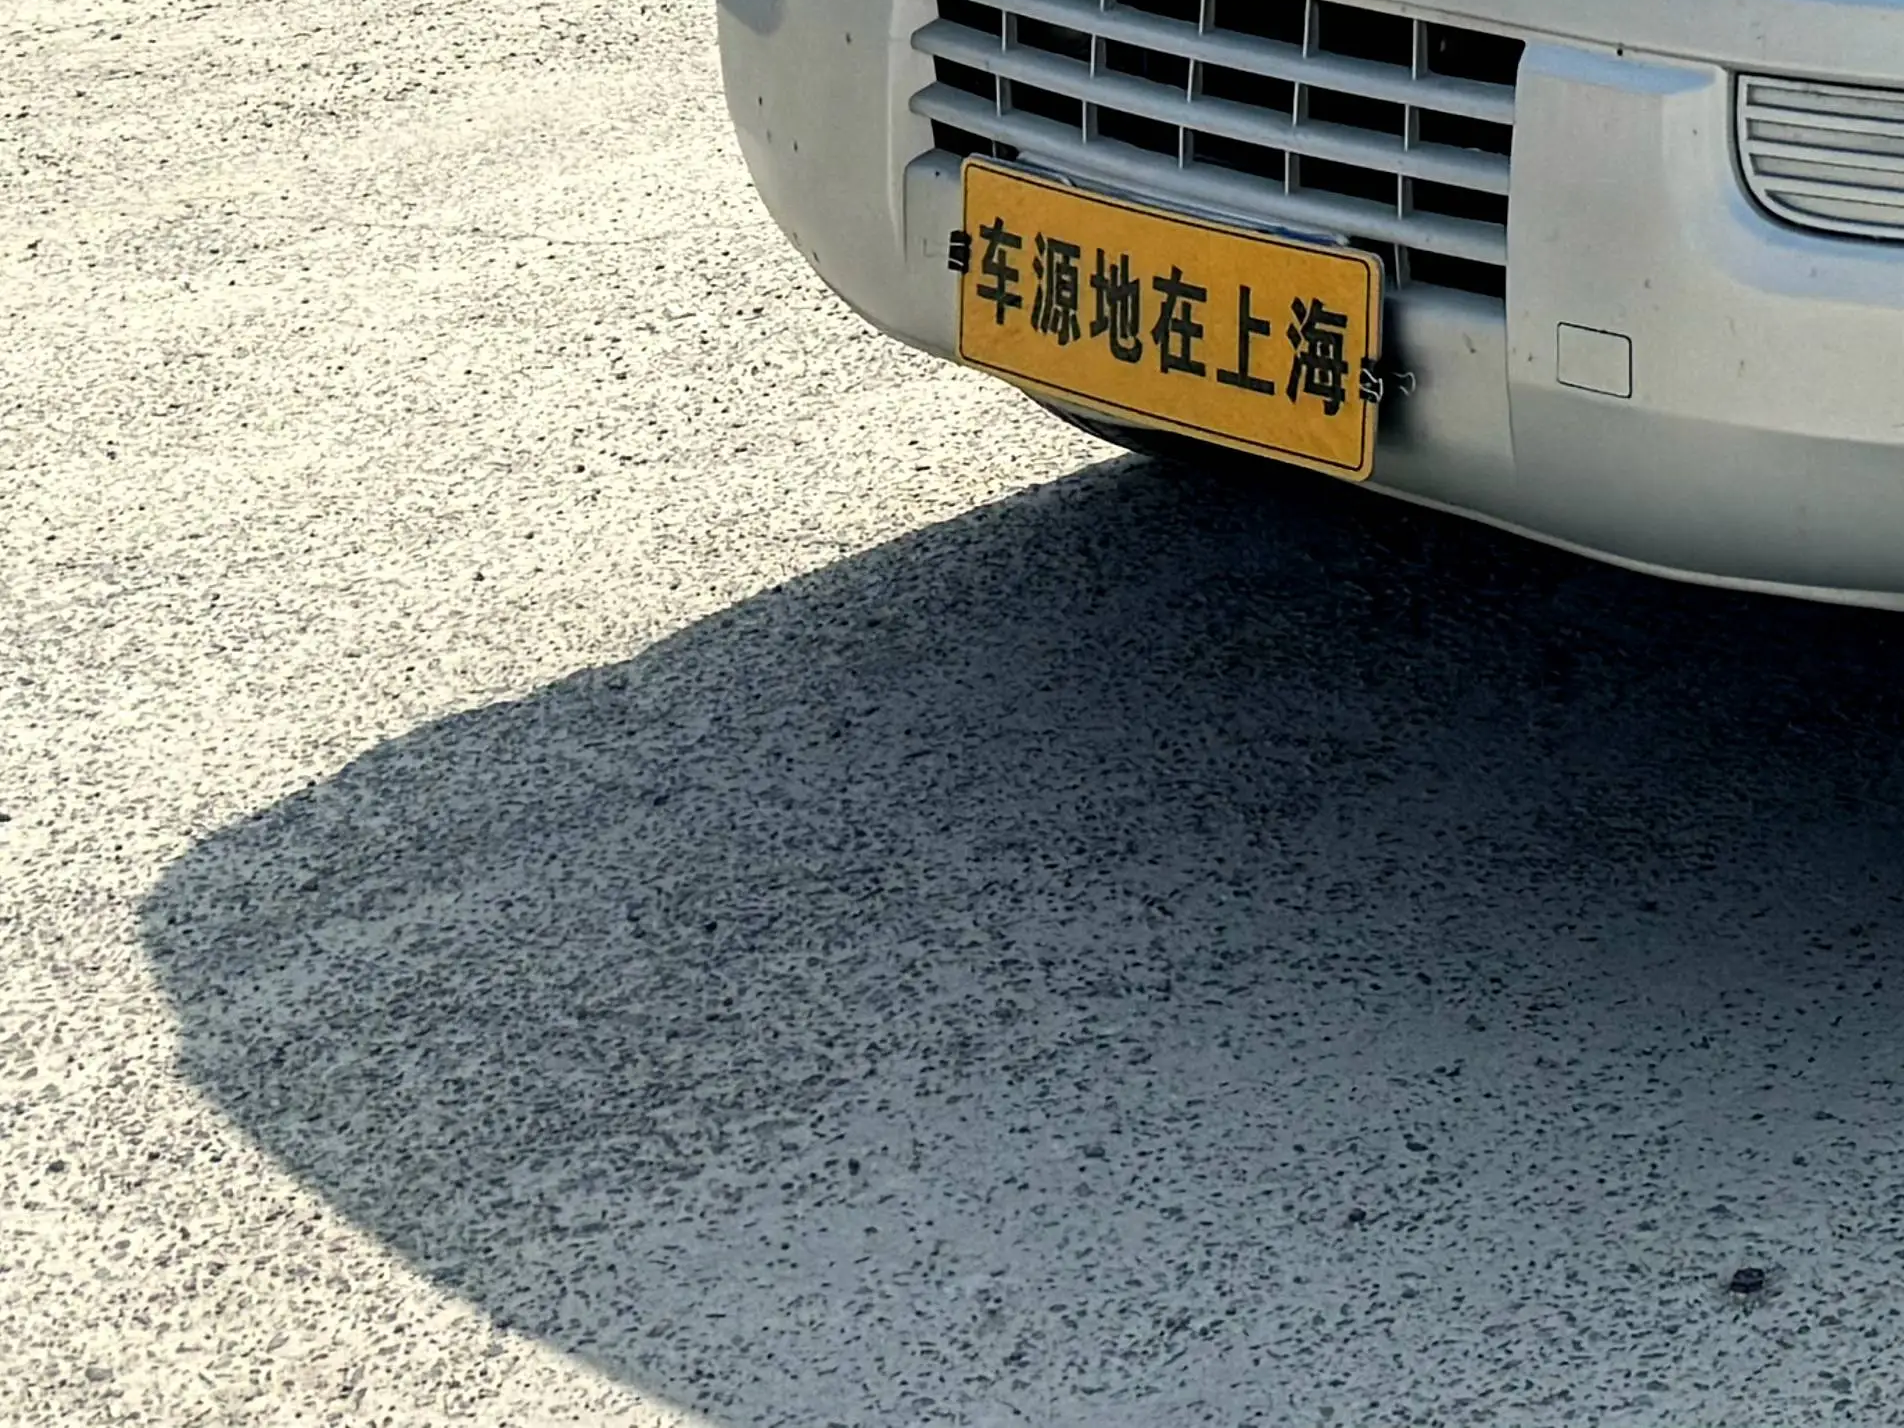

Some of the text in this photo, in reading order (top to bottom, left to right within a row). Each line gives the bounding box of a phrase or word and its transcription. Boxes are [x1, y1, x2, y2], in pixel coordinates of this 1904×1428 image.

[974, 216, 1351, 418] 车源地在上海
